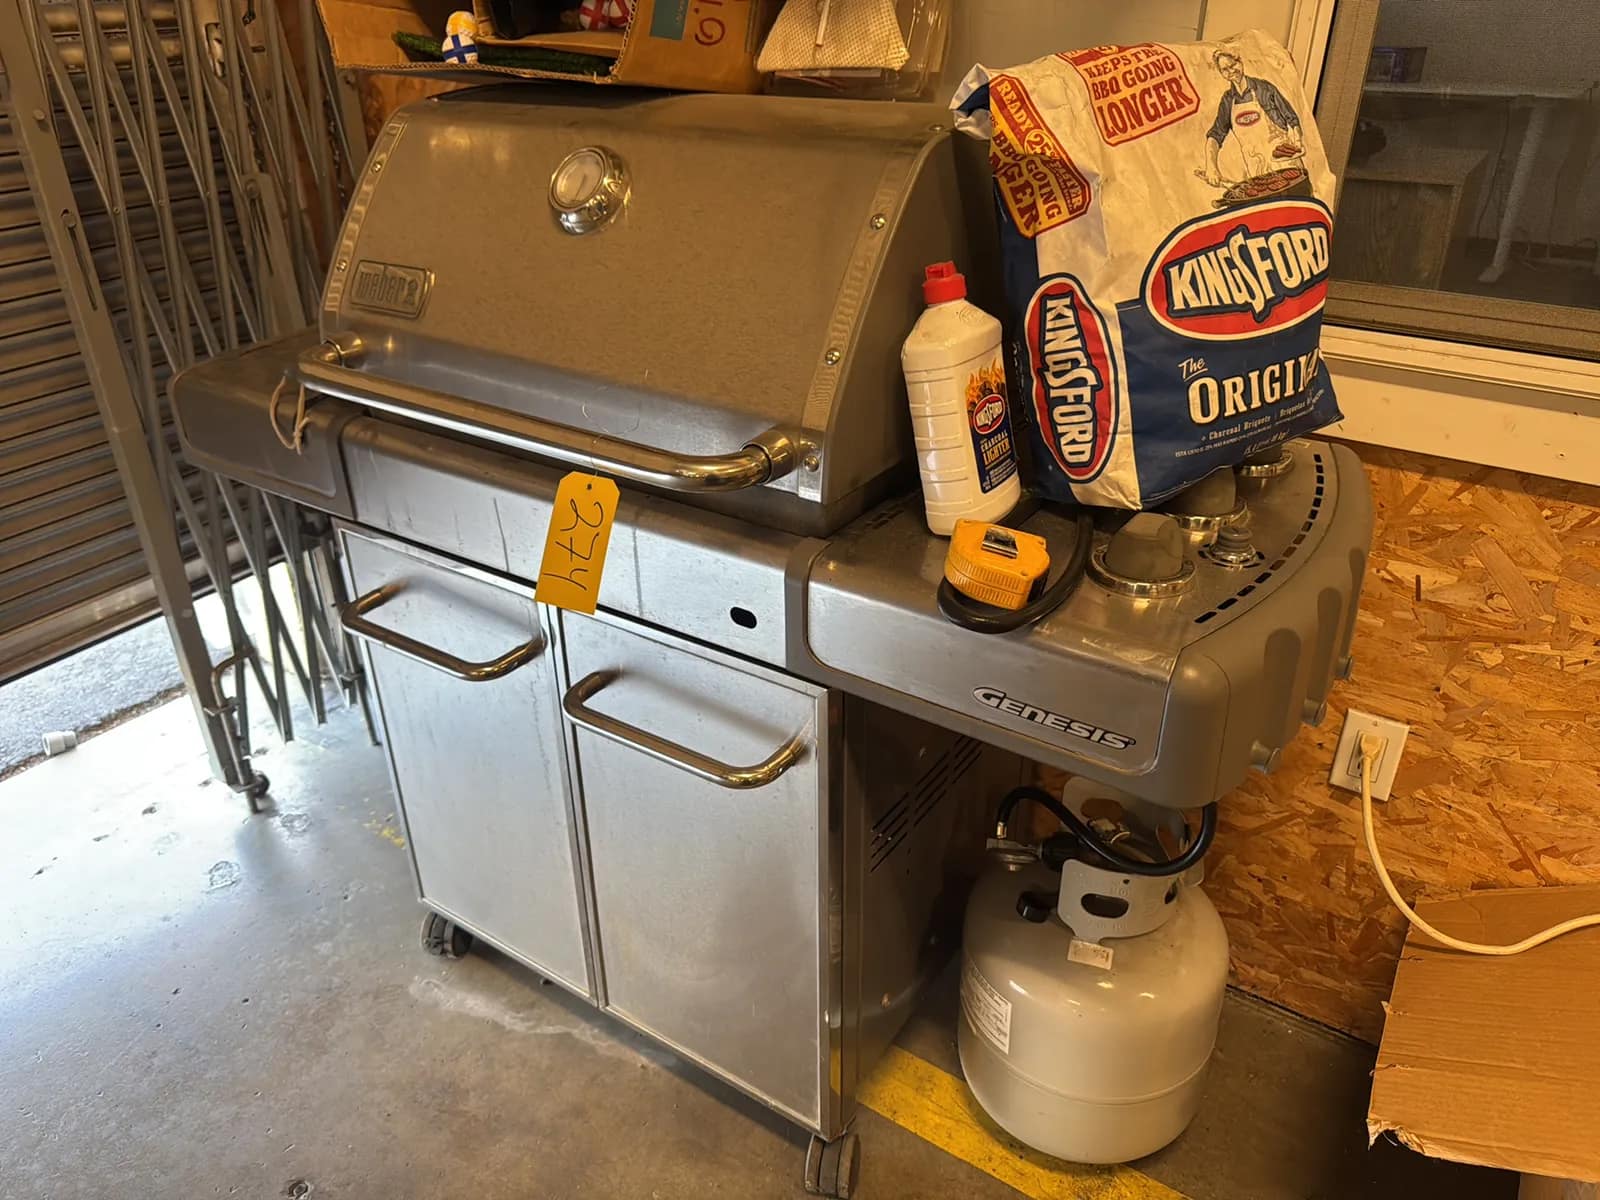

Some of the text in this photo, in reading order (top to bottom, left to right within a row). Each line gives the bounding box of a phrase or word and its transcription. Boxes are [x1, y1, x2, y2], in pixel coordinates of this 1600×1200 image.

[1083, 54, 1132, 79] KEEPS
[1092, 55, 1176, 100] BBQ GOING
[996, 81, 1034, 132] READY
[1097, 77, 1194, 139] LONGER
[991, 130, 1063, 220] BBQ GOING
[1169, 227, 1329, 314] KINGSFORD
[1043, 296, 1098, 464] KINGSFORD
[1178, 357, 1208, 380] The
[983, 438, 1010, 466] LIGHTER
[543, 498, 604, 591] 274
[972, 686, 1132, 750] GENESIS
